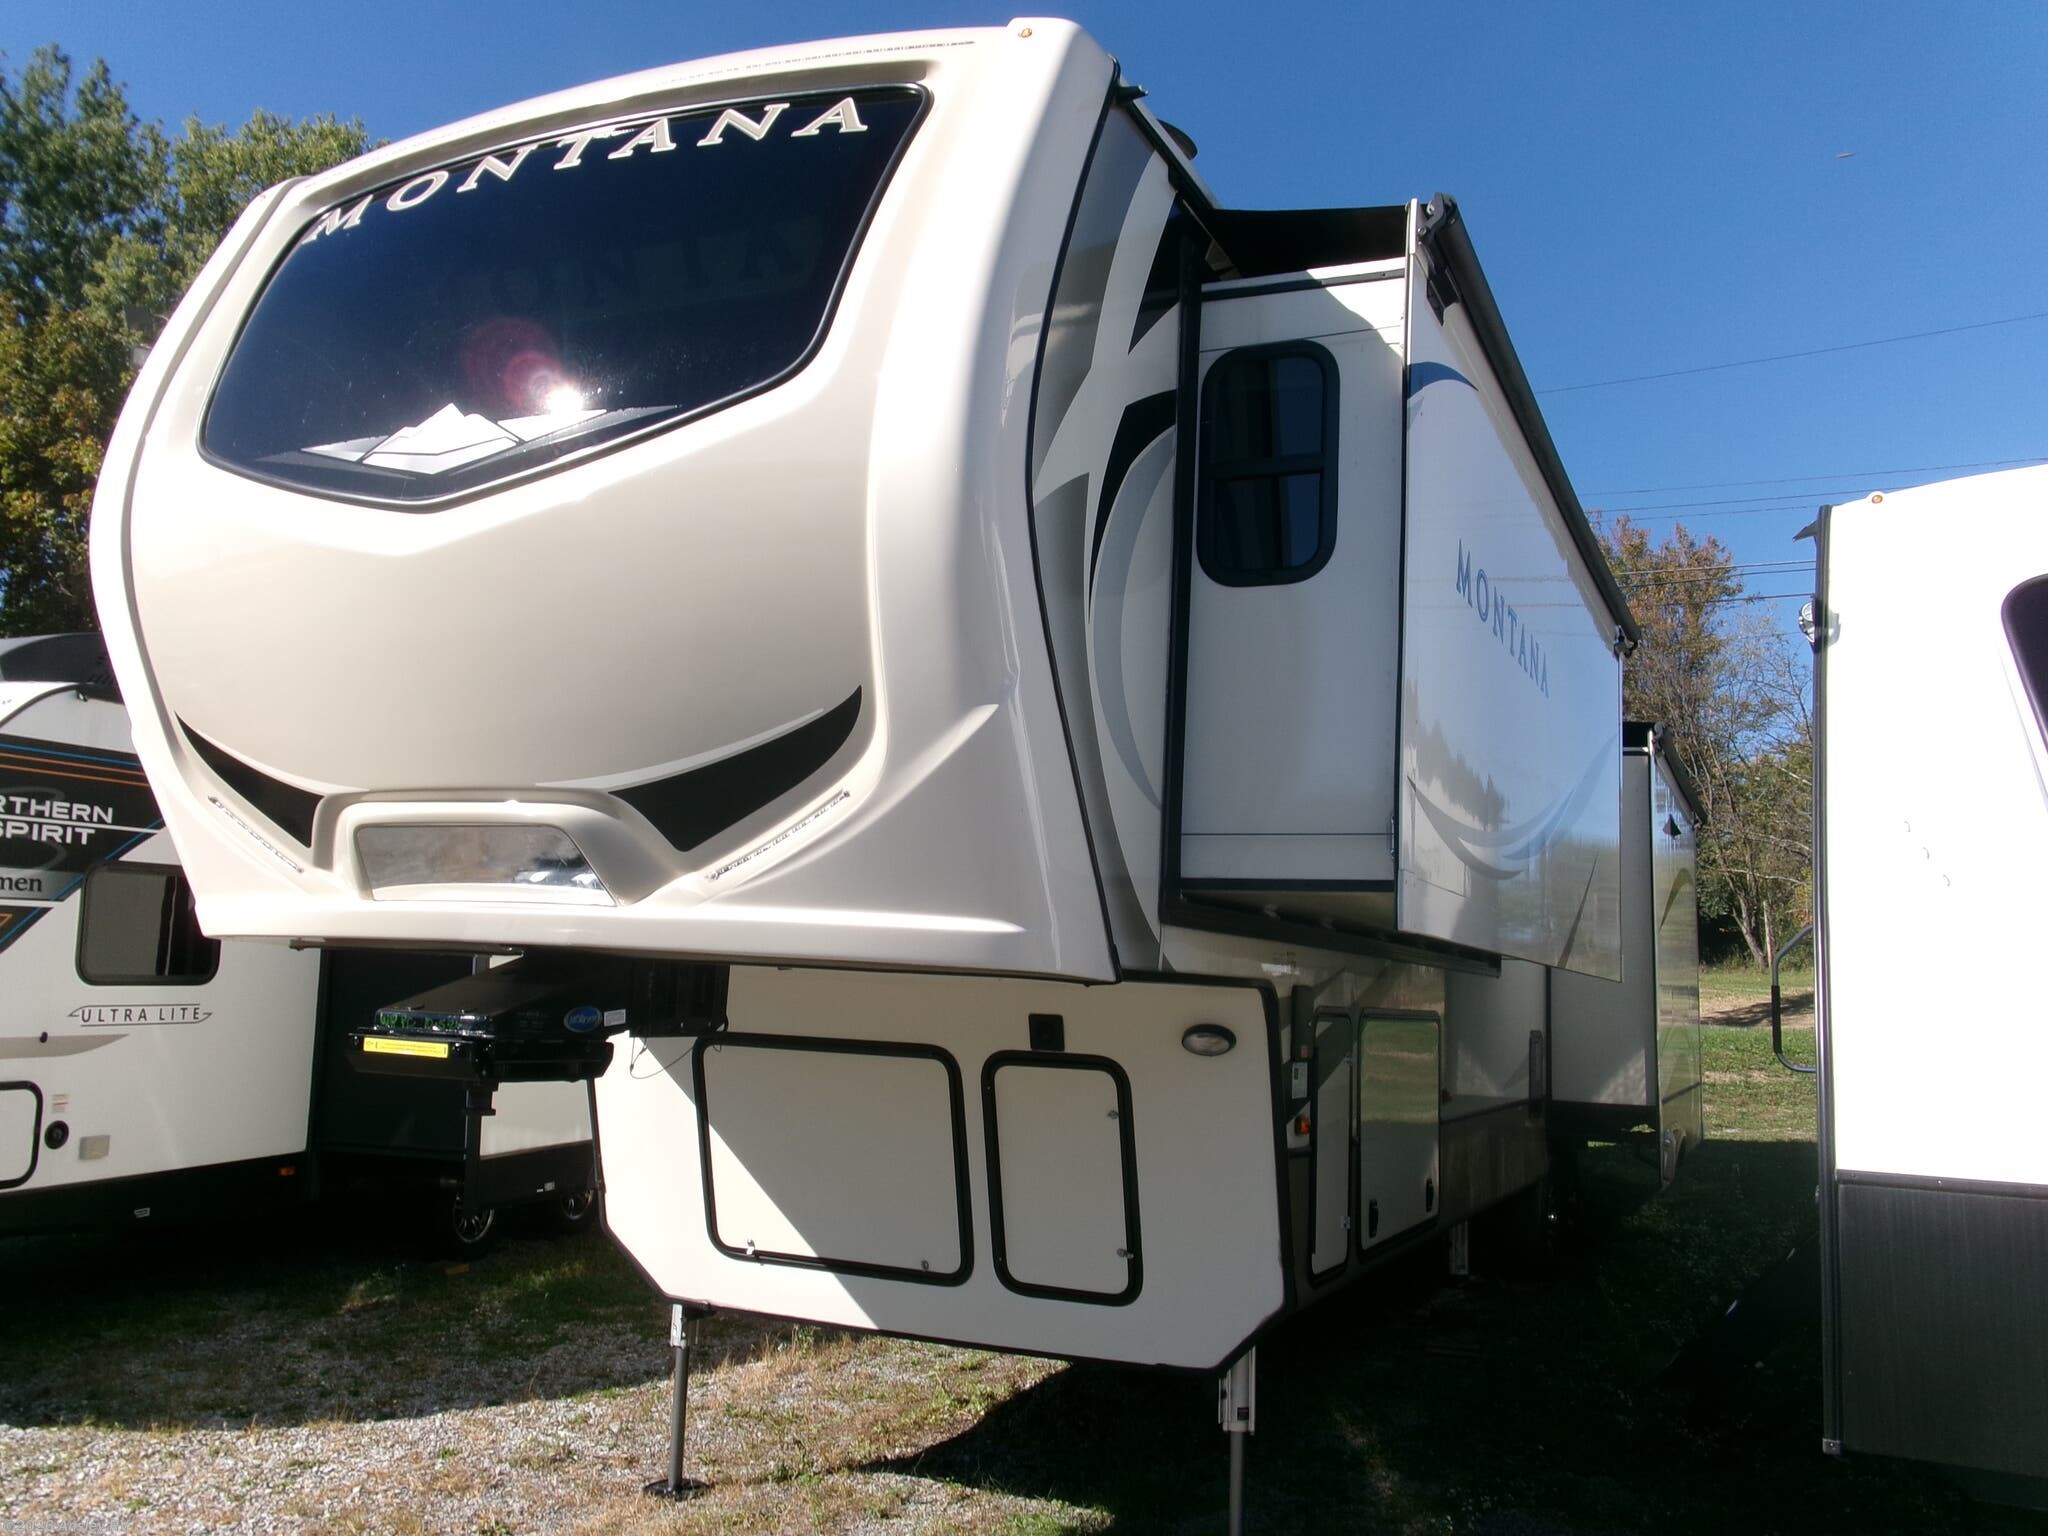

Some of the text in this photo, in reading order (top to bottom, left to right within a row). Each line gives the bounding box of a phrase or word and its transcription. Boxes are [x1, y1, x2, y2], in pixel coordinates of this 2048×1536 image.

[301, 97, 868, 245] MONTANA
[1456, 538, 1549, 699] MONTANA
[0, 820, 95, 845] PIRIT
[81, 1007, 200, 1023] ULTRA LITE
